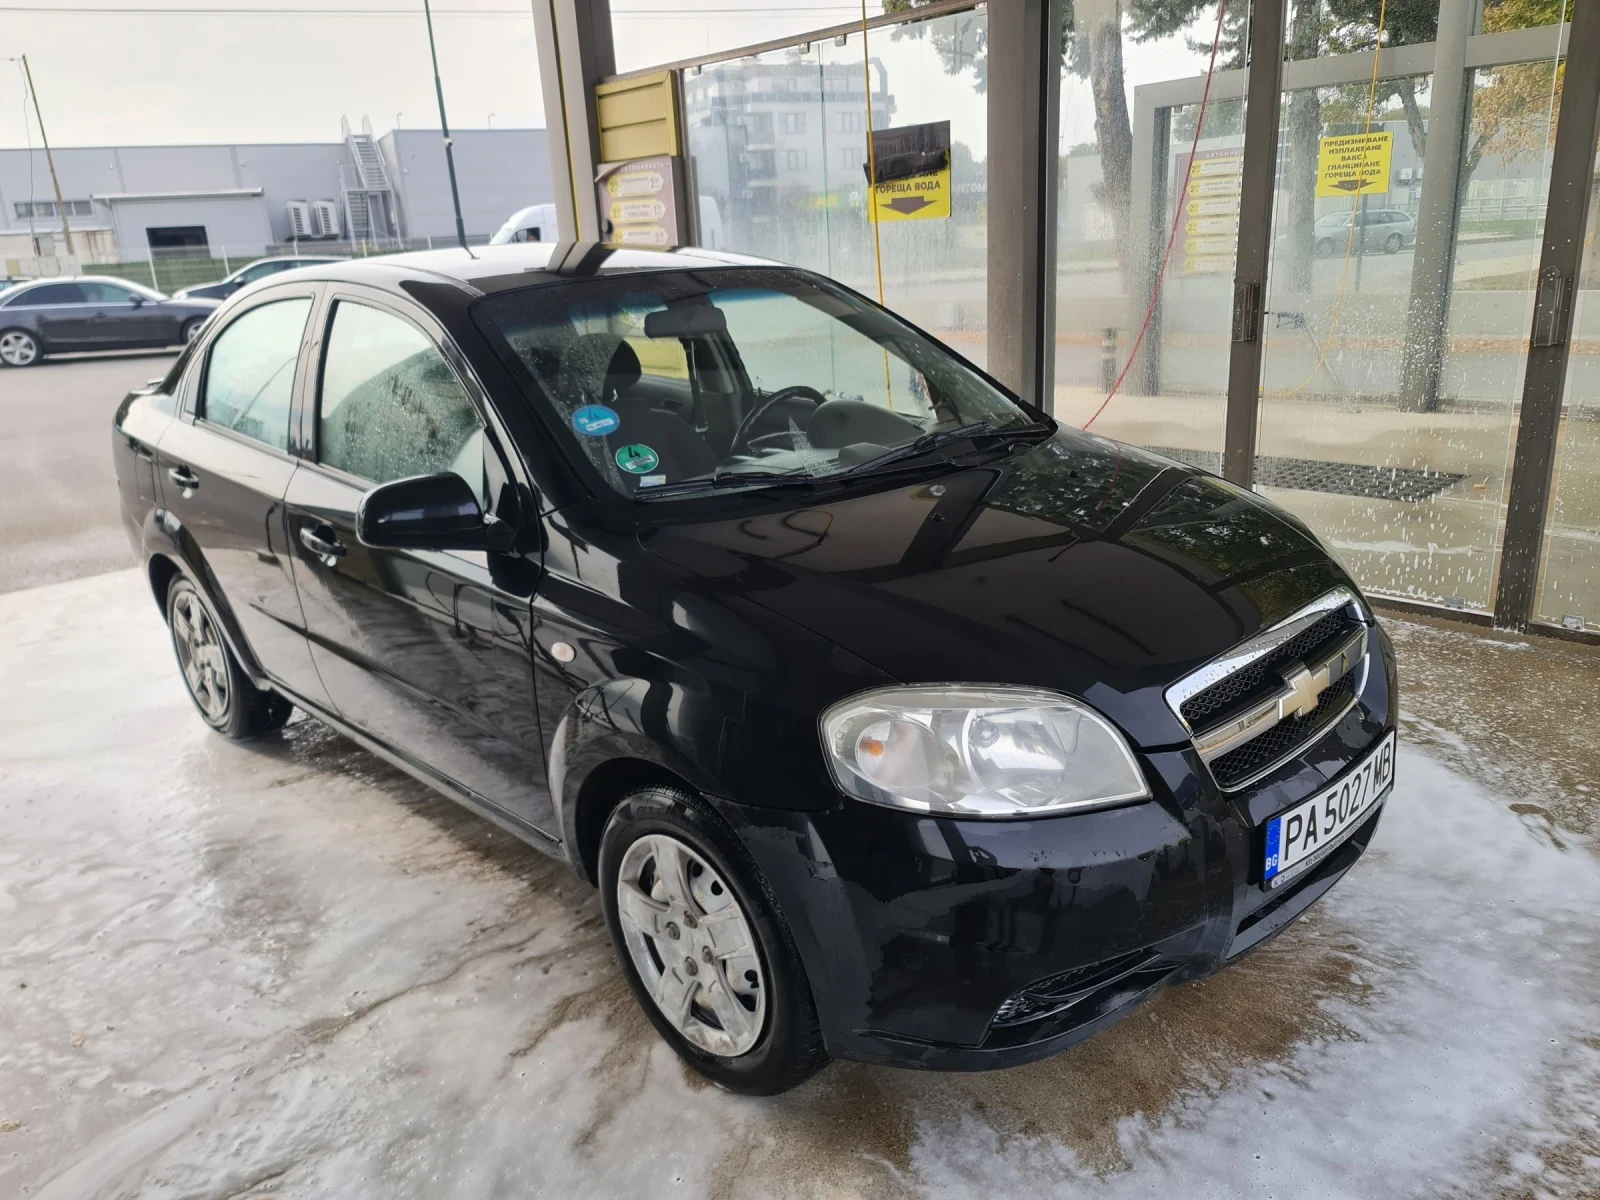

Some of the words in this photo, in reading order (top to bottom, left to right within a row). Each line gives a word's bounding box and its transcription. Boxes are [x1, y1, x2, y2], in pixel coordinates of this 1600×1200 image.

[1324, 136, 1388, 147] ПРЕДИЗМИВАНЕ
[1329, 145, 1382, 155] ИЗПЛАКВАНЕ
[1325, 171, 1356, 179] ГОРЕЩА
[875, 183, 912, 194] ГОРЕЩА
[914, 181, 941, 191] ВОДА
[1285, 804, 1318, 861] PA
[1324, 761, 1372, 835] 5027
[1373, 741, 1391, 794] MB
[1265, 854, 1278, 871] BG
